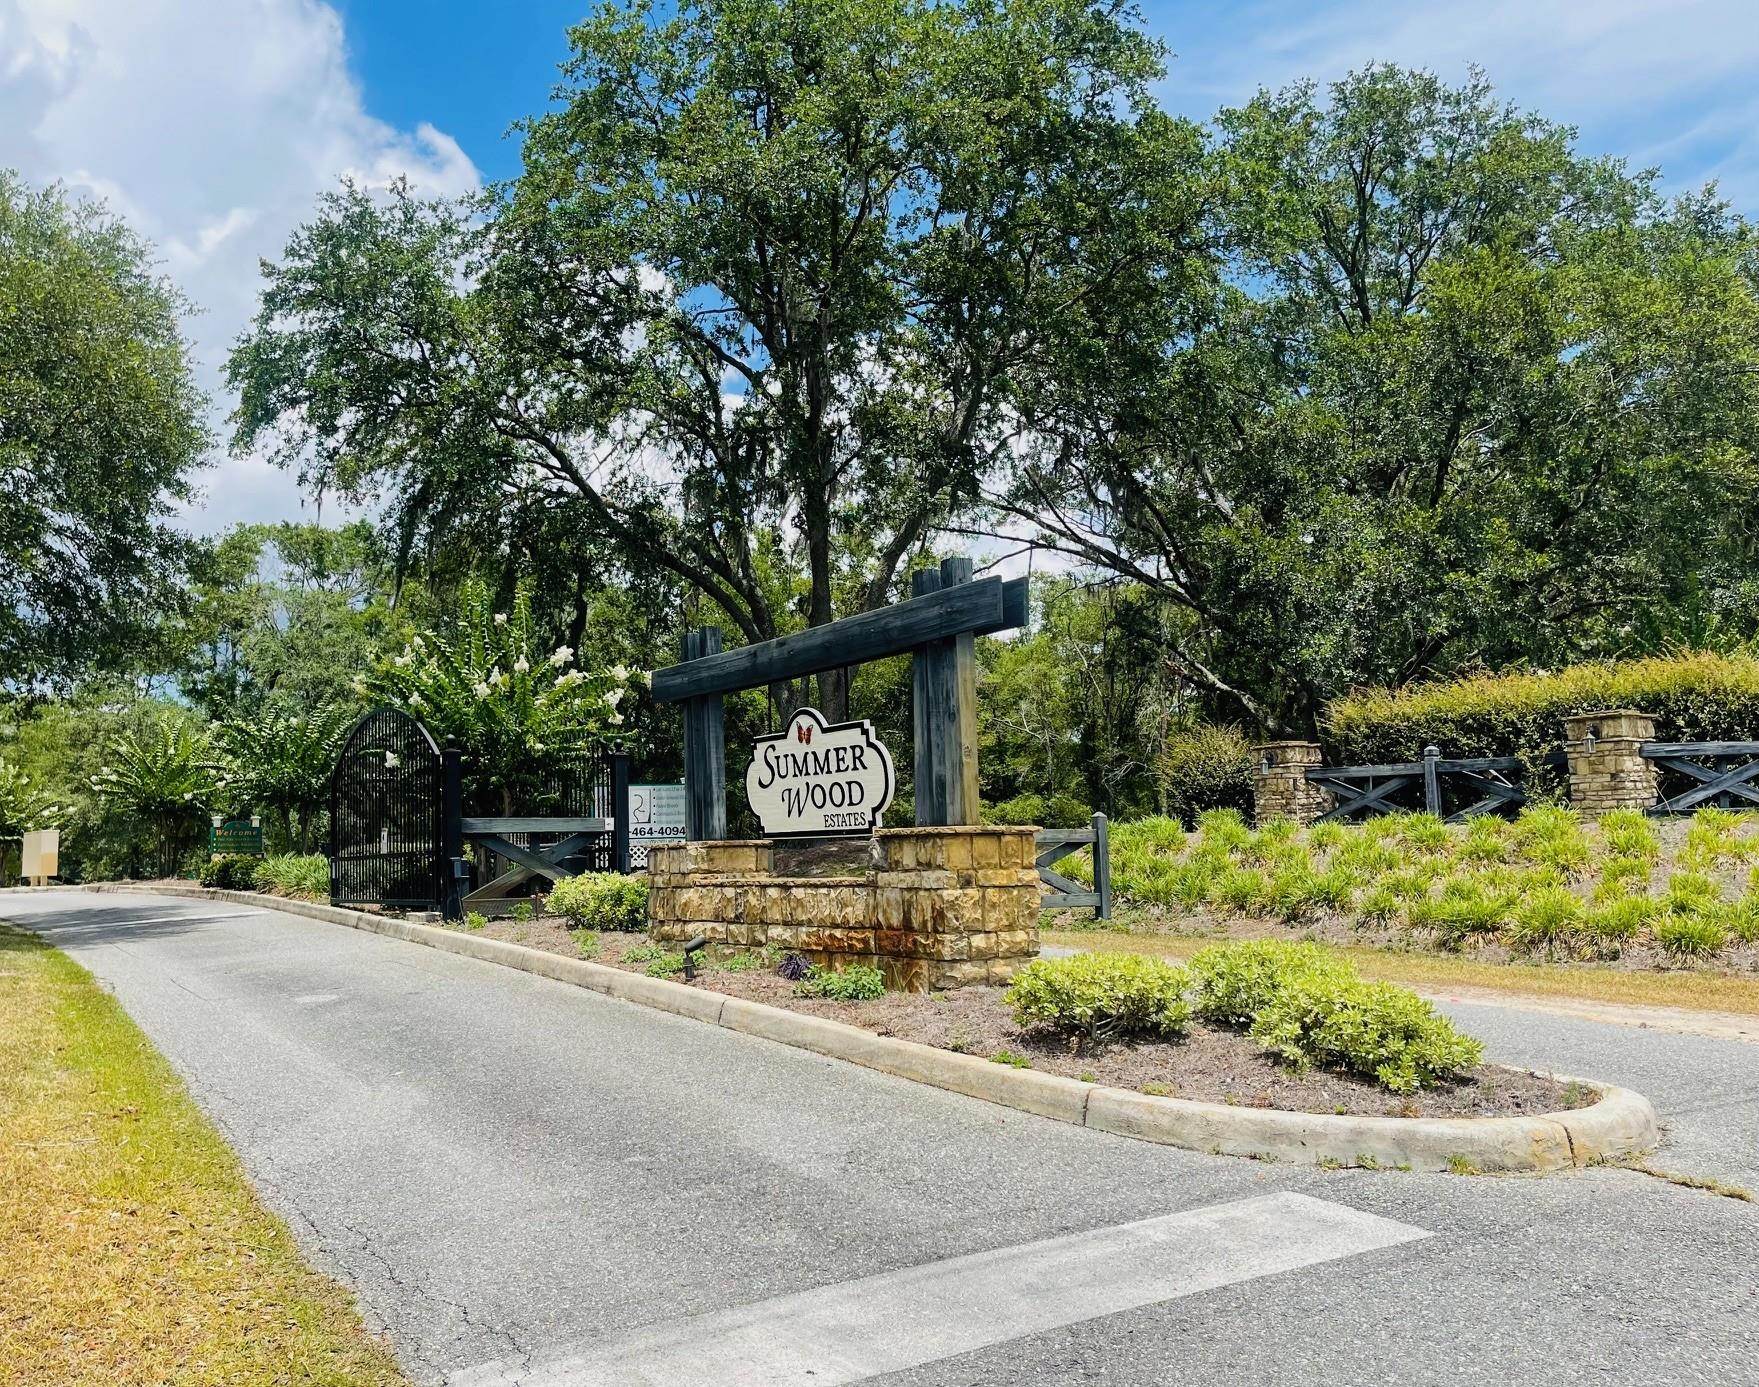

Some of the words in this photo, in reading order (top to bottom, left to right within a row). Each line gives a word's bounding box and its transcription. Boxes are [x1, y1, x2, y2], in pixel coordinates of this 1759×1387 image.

[758, 744, 868, 789] SUMMER
[781, 780, 865, 818] WOOD
[823, 812, 867, 828] ESTATES
